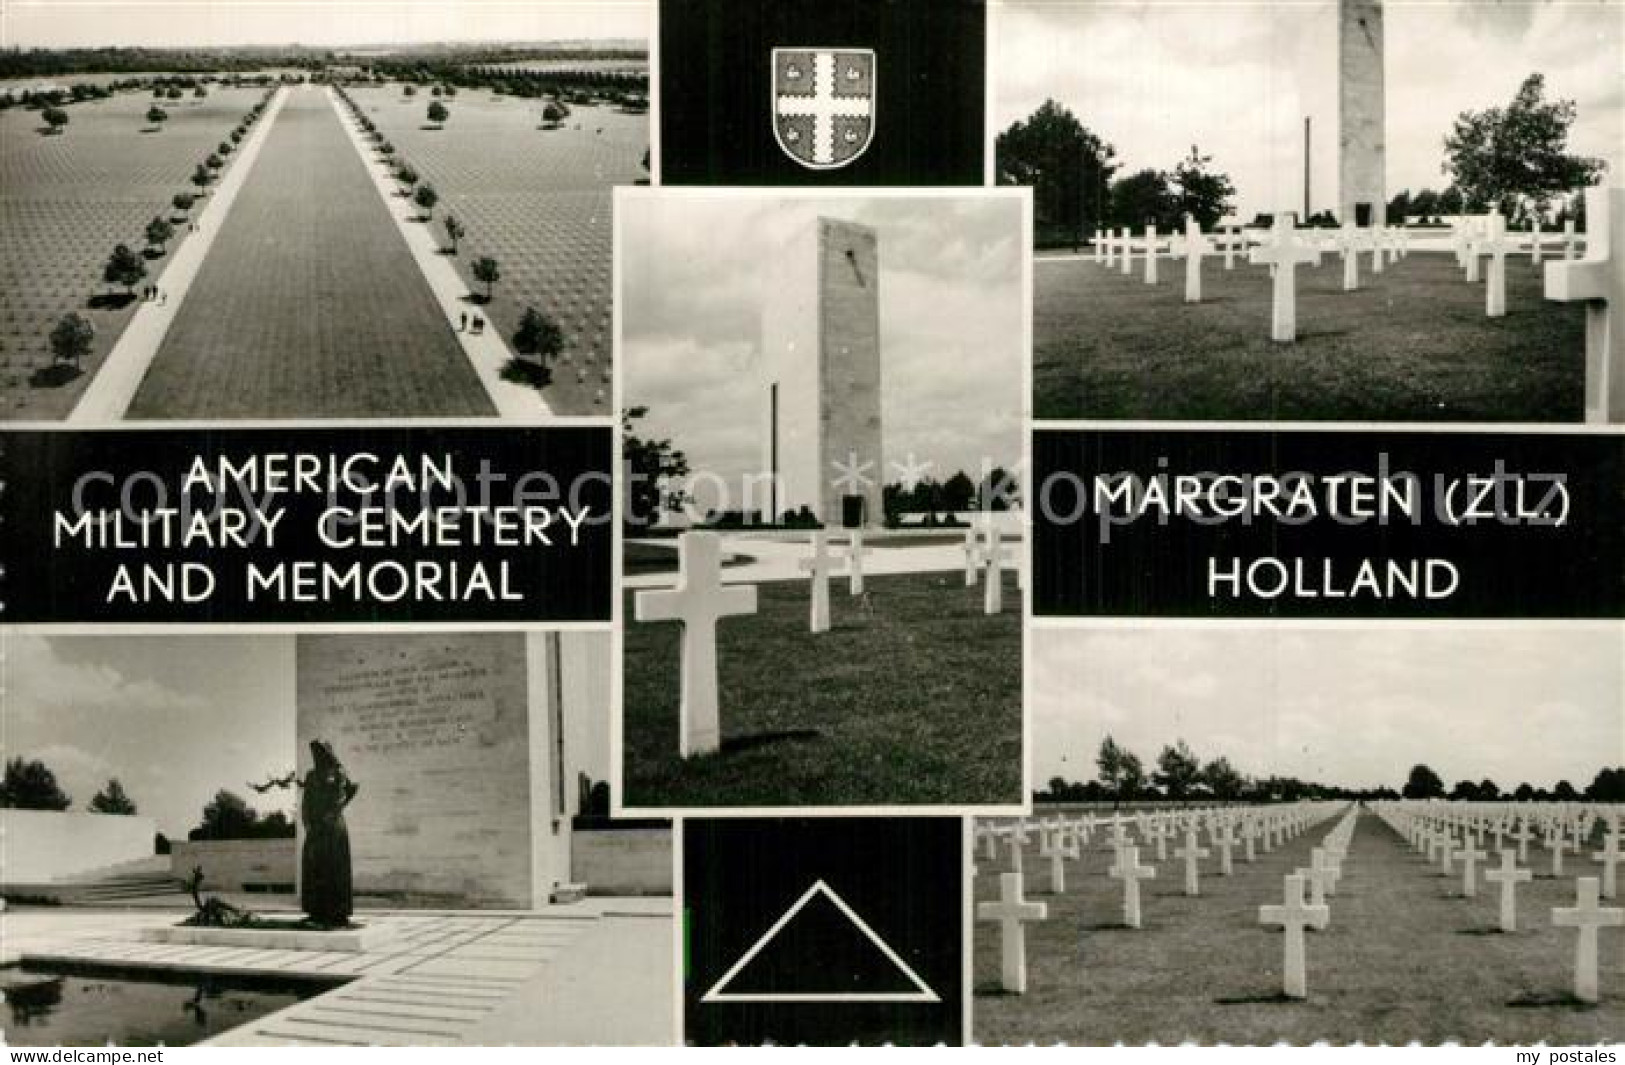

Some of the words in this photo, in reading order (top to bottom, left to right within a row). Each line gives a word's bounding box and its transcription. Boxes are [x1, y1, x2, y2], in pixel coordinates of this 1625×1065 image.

[182, 452, 453, 494] AMERICAN
[1095, 475, 1413, 516] MARGRATEN
[1445, 477, 1571, 527] (Z.L.)
[55, 507, 285, 548] MILITARY
[317, 505, 590, 548] CEMETERY
[107, 562, 215, 603] AND
[248, 561, 524, 602] MEMORIAL
[1209, 557, 1459, 598] HOLLAND
